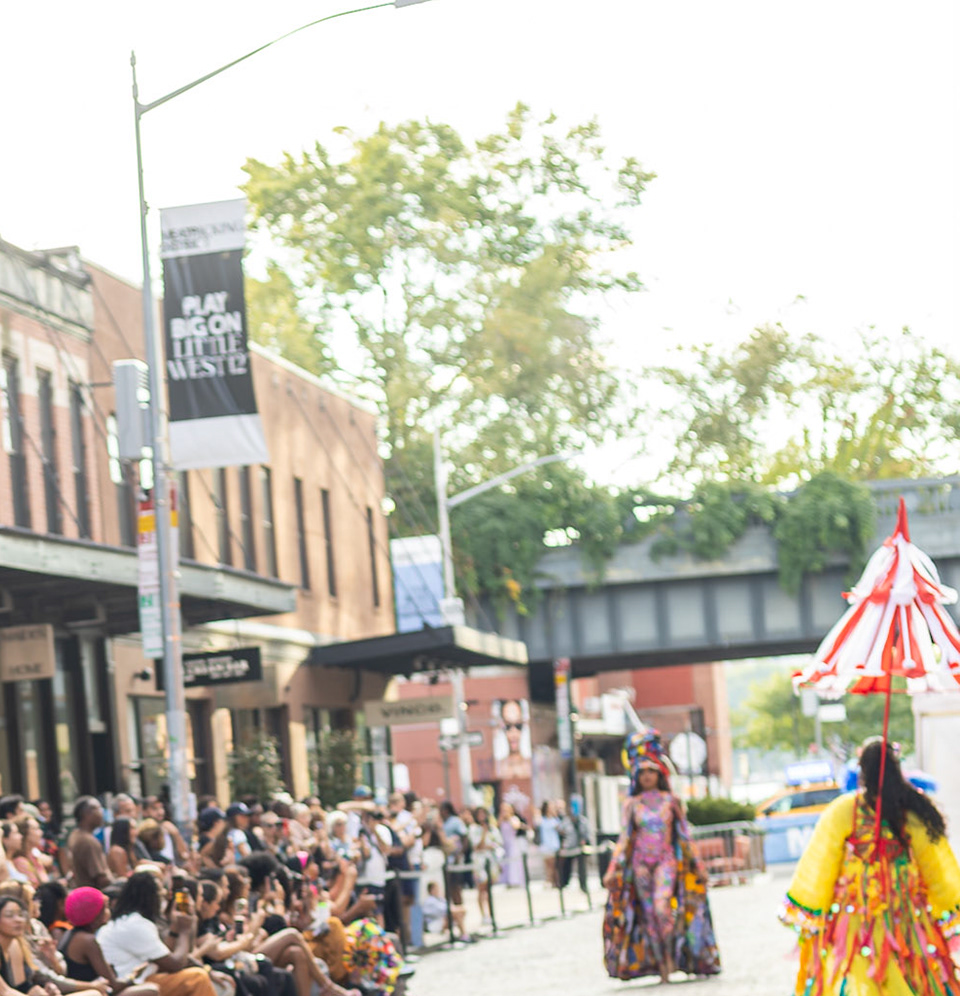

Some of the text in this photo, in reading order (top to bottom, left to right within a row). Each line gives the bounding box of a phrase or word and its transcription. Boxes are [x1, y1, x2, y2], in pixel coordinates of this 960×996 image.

[182, 291, 227, 316] PLAY
[169, 311, 242, 339] BIG ON
[173, 333, 243, 358] LITTLE
[168, 355, 224, 380] WEST
